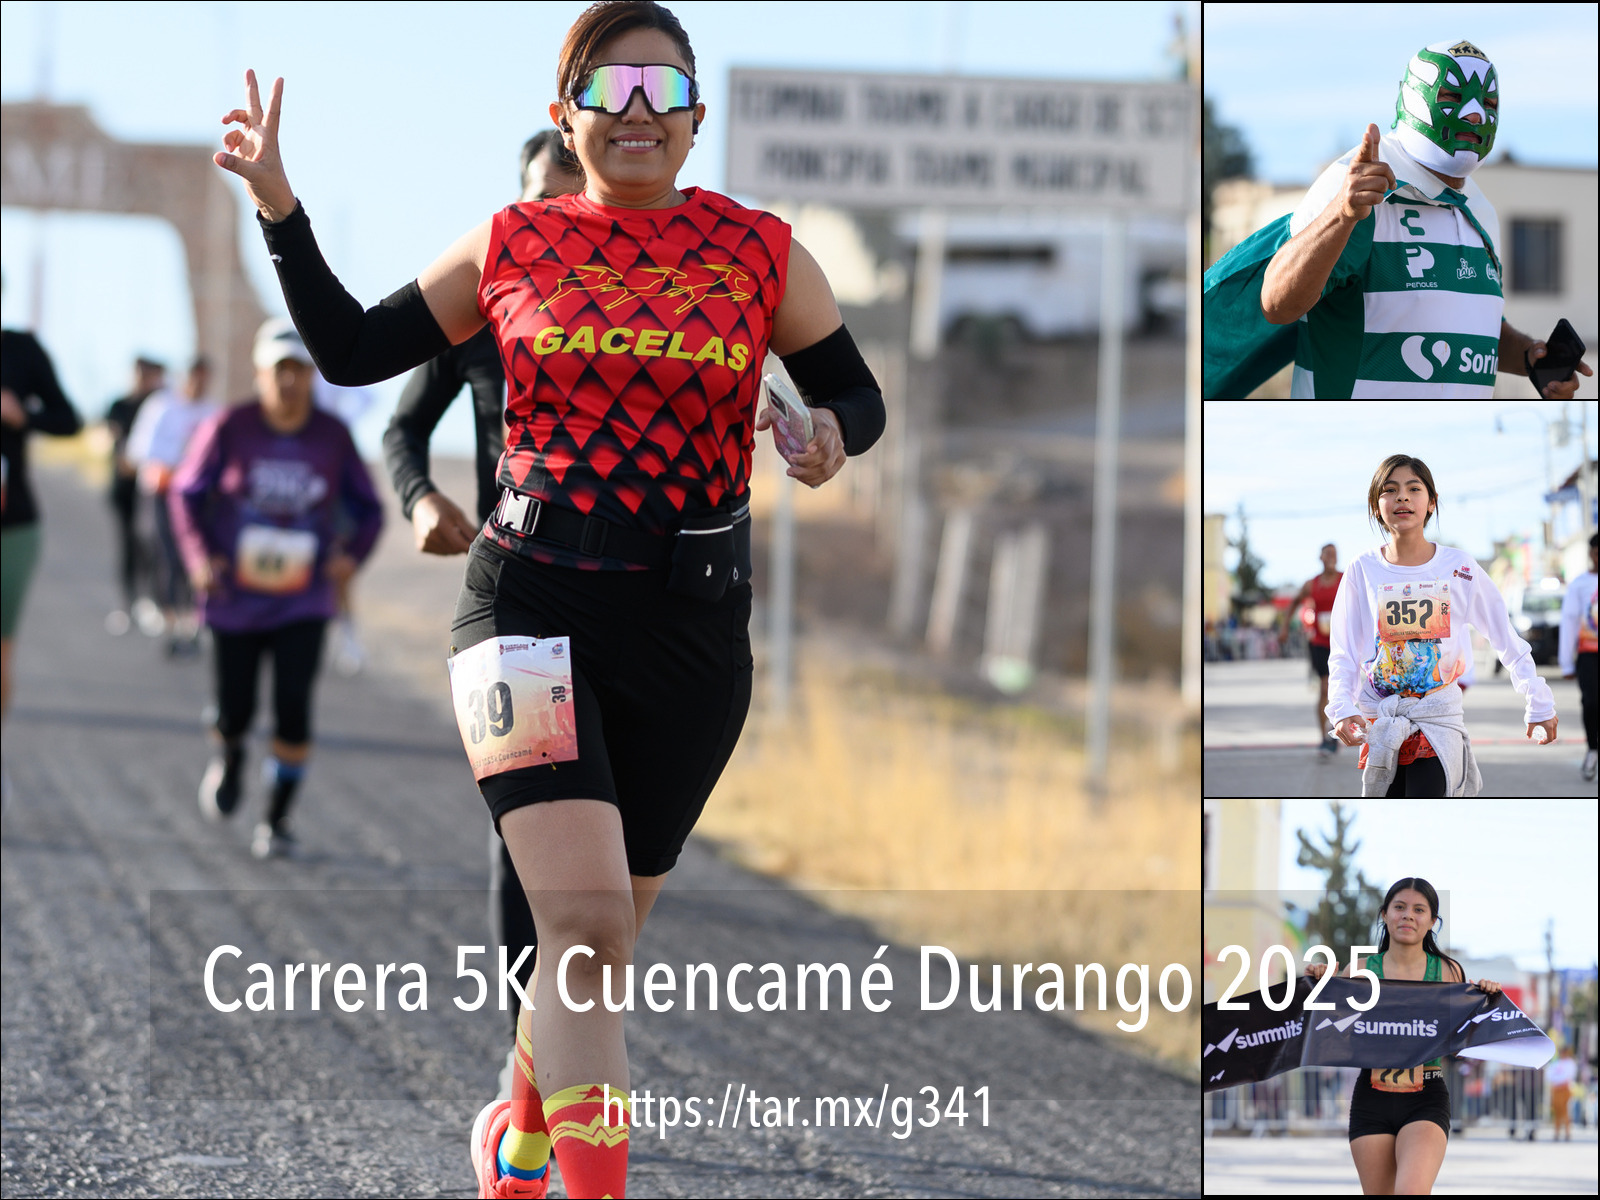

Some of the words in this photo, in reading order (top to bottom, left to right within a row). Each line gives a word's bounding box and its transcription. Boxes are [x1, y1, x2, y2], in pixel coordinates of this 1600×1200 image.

[533, 326, 749, 371] GACELAS
[1386, 599, 1433, 629] 352
[551, 685, 566, 703] 39
[468, 681, 514, 745] 39
[1235, 1018, 1303, 1050] summits
[1354, 1018, 1437, 1037] summits
